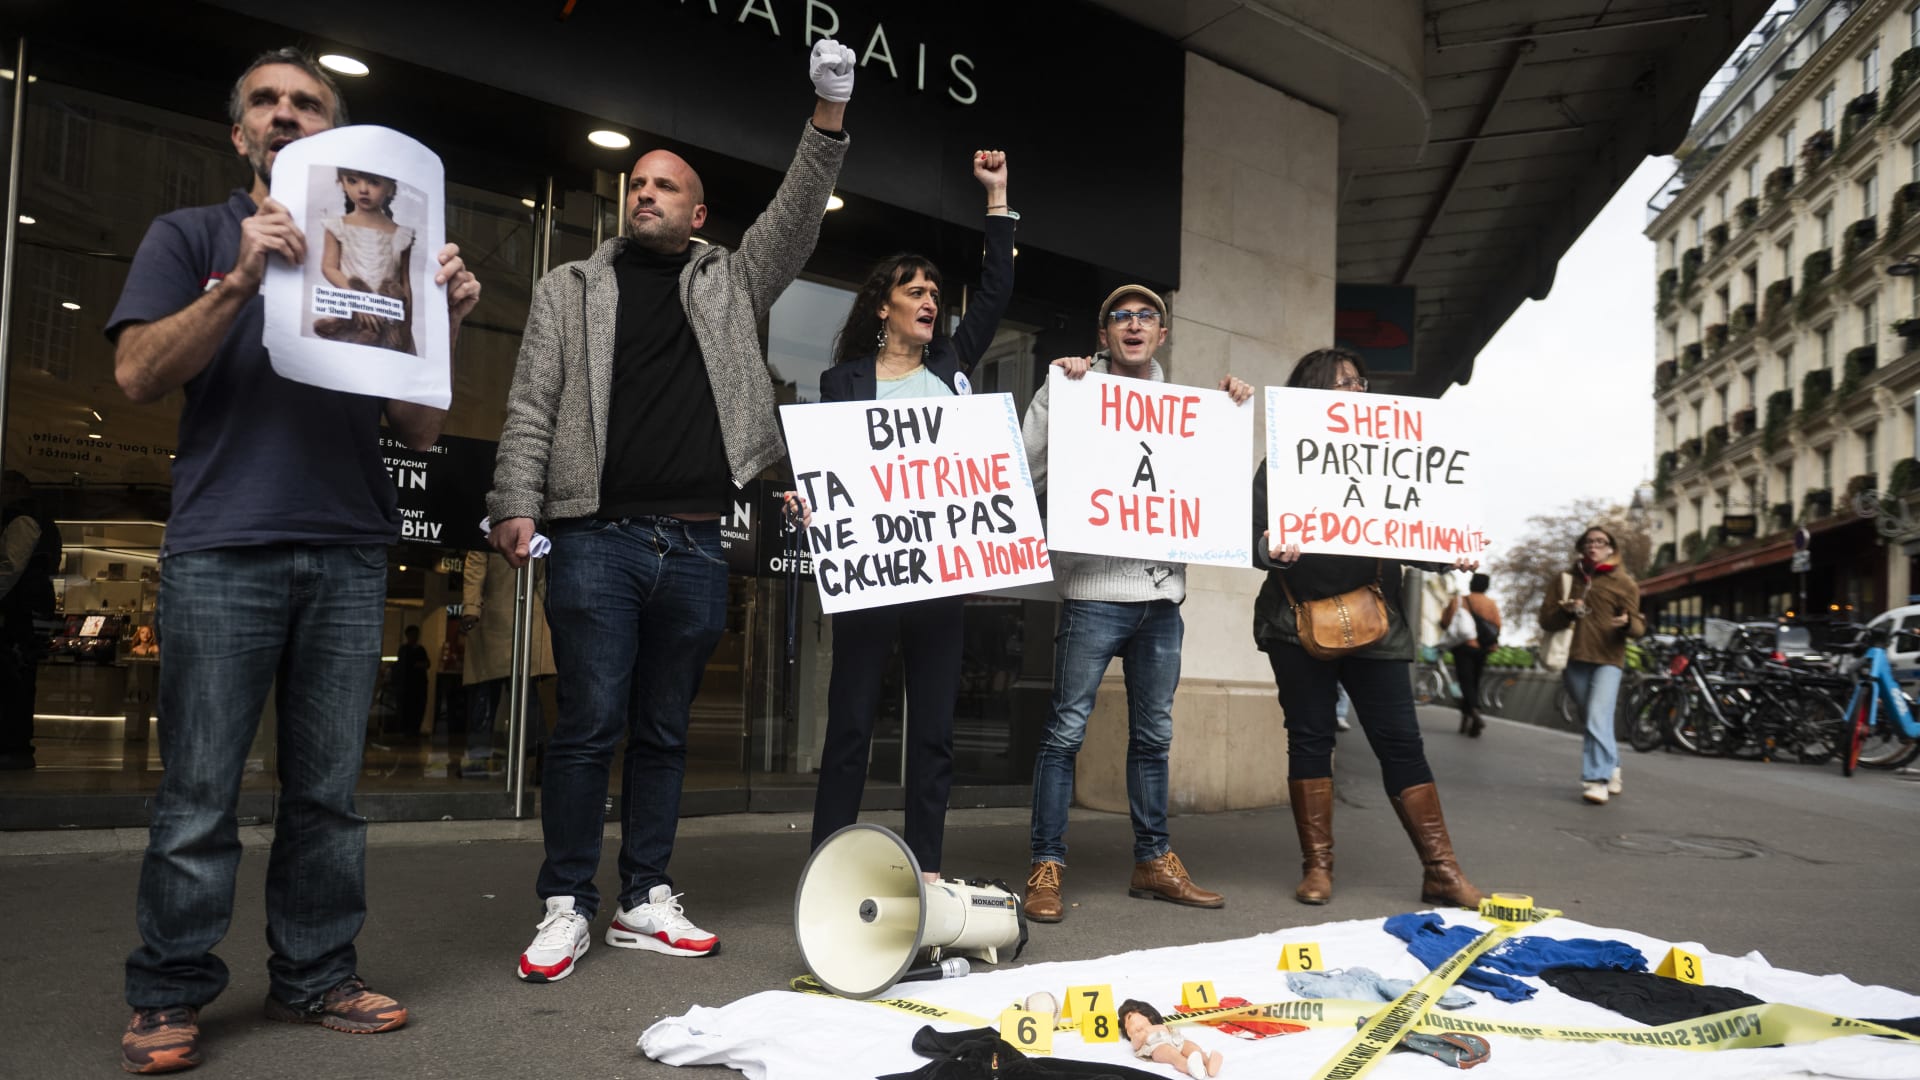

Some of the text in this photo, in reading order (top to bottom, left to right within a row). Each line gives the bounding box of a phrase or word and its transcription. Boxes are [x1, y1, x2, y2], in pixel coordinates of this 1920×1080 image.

[680, 0, 978, 104] ARAIS
[866, 406, 943, 450] BHV
[1101, 383, 1201, 438] HONTE
[1326, 400, 1423, 442] SHEIN
[393, 458, 428, 469] D'ACHAT
[1132, 441, 1157, 492] À
[1297, 438, 1470, 485] PARTICIPE
[797, 452, 1011, 513] TA VITRINE
[1343, 477, 1421, 512] À LA
[402, 520, 442, 539] BHV
[809, 518, 858, 554] NE
[872, 510, 936, 544] DOIT
[947, 494, 1018, 539] PAS
[1088, 488, 1200, 540] SHEIN
[818, 536, 1050, 597] CACHER LA HONTE
[972, 897, 1005, 907] MONACOR
[1298, 948, 1313, 970] 5
[1683, 956, 1696, 980] 3
[1083, 991, 1099, 1011] 7
[1196, 984, 1209, 1003] 1
[1017, 1016, 1038, 1045] 6
[1094, 1015, 1109, 1038] 8
